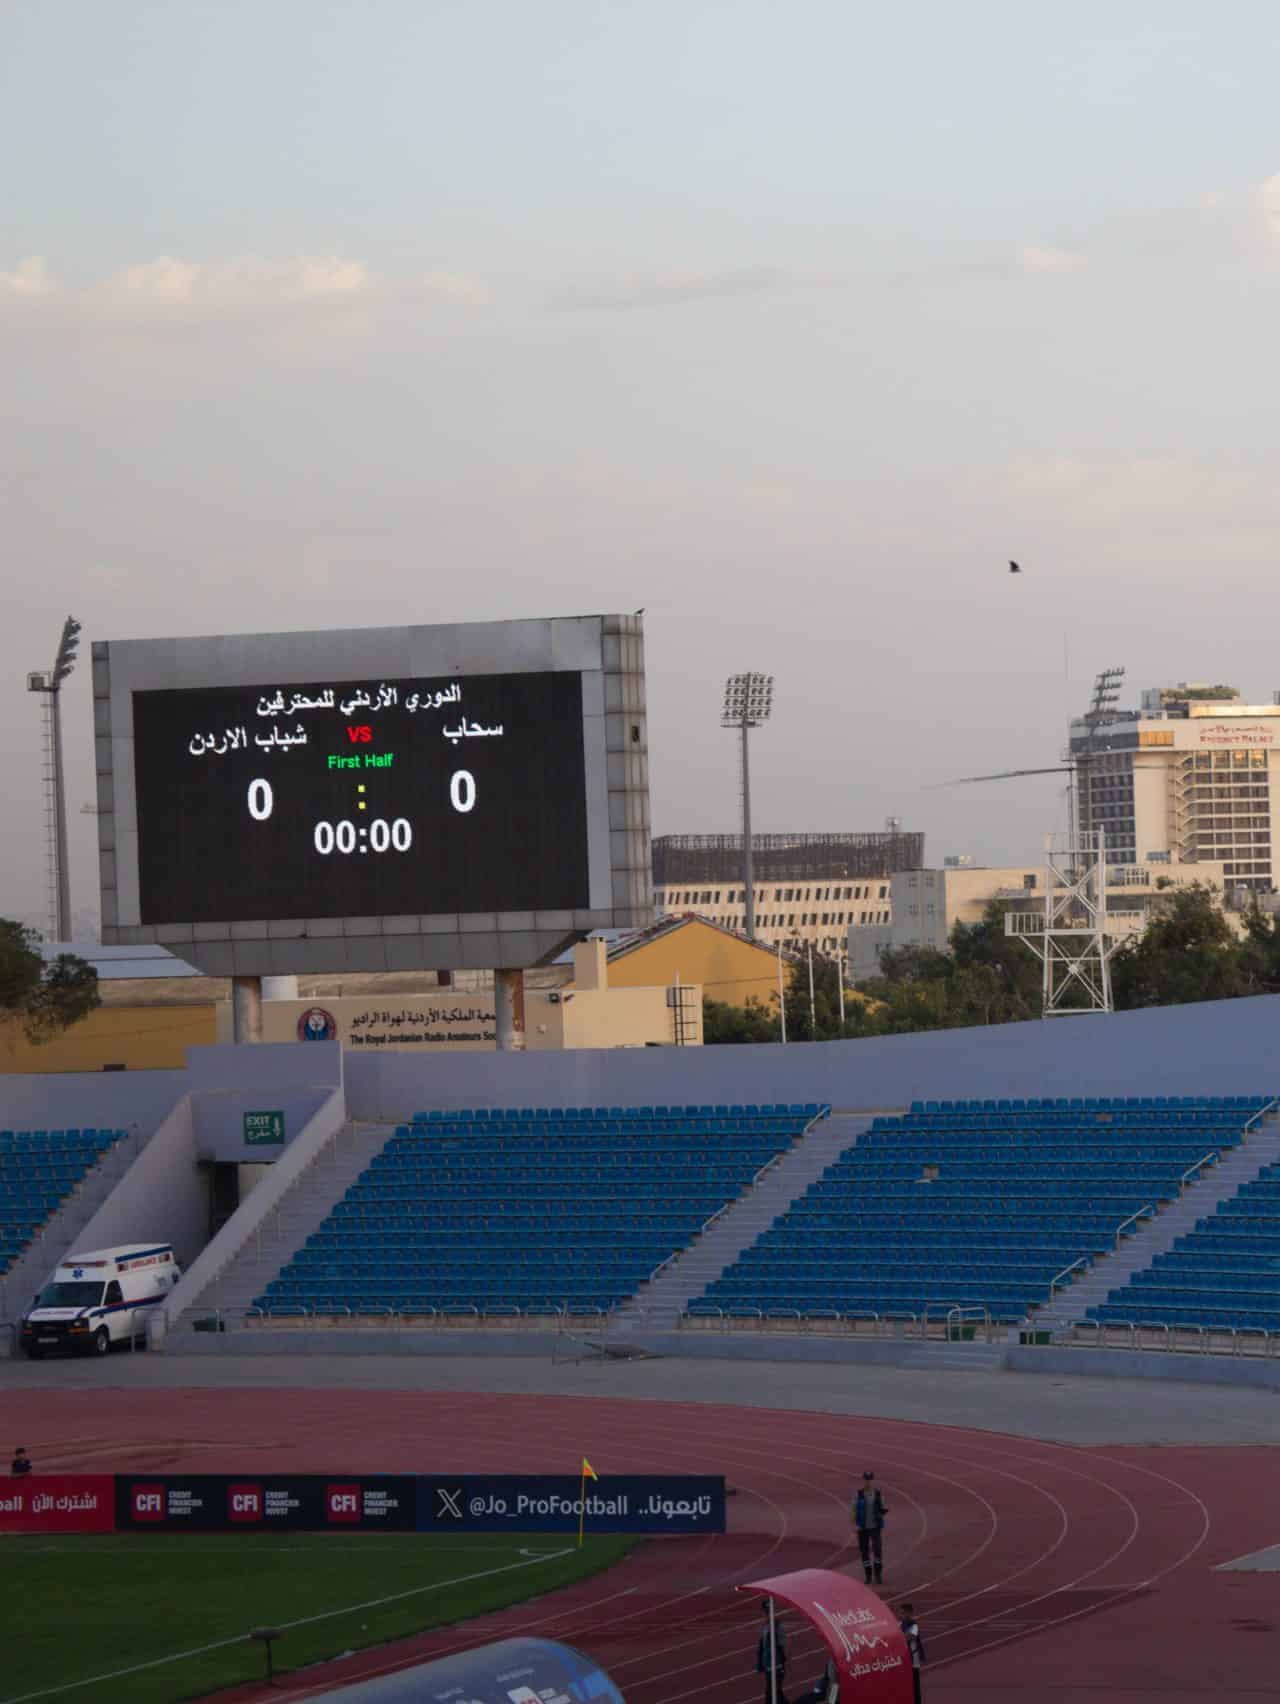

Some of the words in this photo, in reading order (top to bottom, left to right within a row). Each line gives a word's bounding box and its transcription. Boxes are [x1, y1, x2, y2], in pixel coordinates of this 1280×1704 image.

[257, 690, 334, 717] للمحترفين
[340, 687, 397, 717] الأردني
[406, 684, 461, 713] الدوري
[189, 727, 247, 756] الاردن
[255, 724, 307, 751] شباب
[347, 726, 372, 744] VS
[443, 717, 503, 745] سحاب
[328, 755, 360, 769] First
[365, 753, 393, 768] Half
[247, 778, 273, 820] 0
[450, 770, 476, 812] 0
[314, 818, 412, 854] 00:00
[56, 1491, 97, 1513] اشترك
[136, 1494, 160, 1512] CFI
[233, 1494, 258, 1512] CFI
[331, 1494, 356, 1512] CFI
[470, 1495, 628, 1517] @Jo_ProFootball
